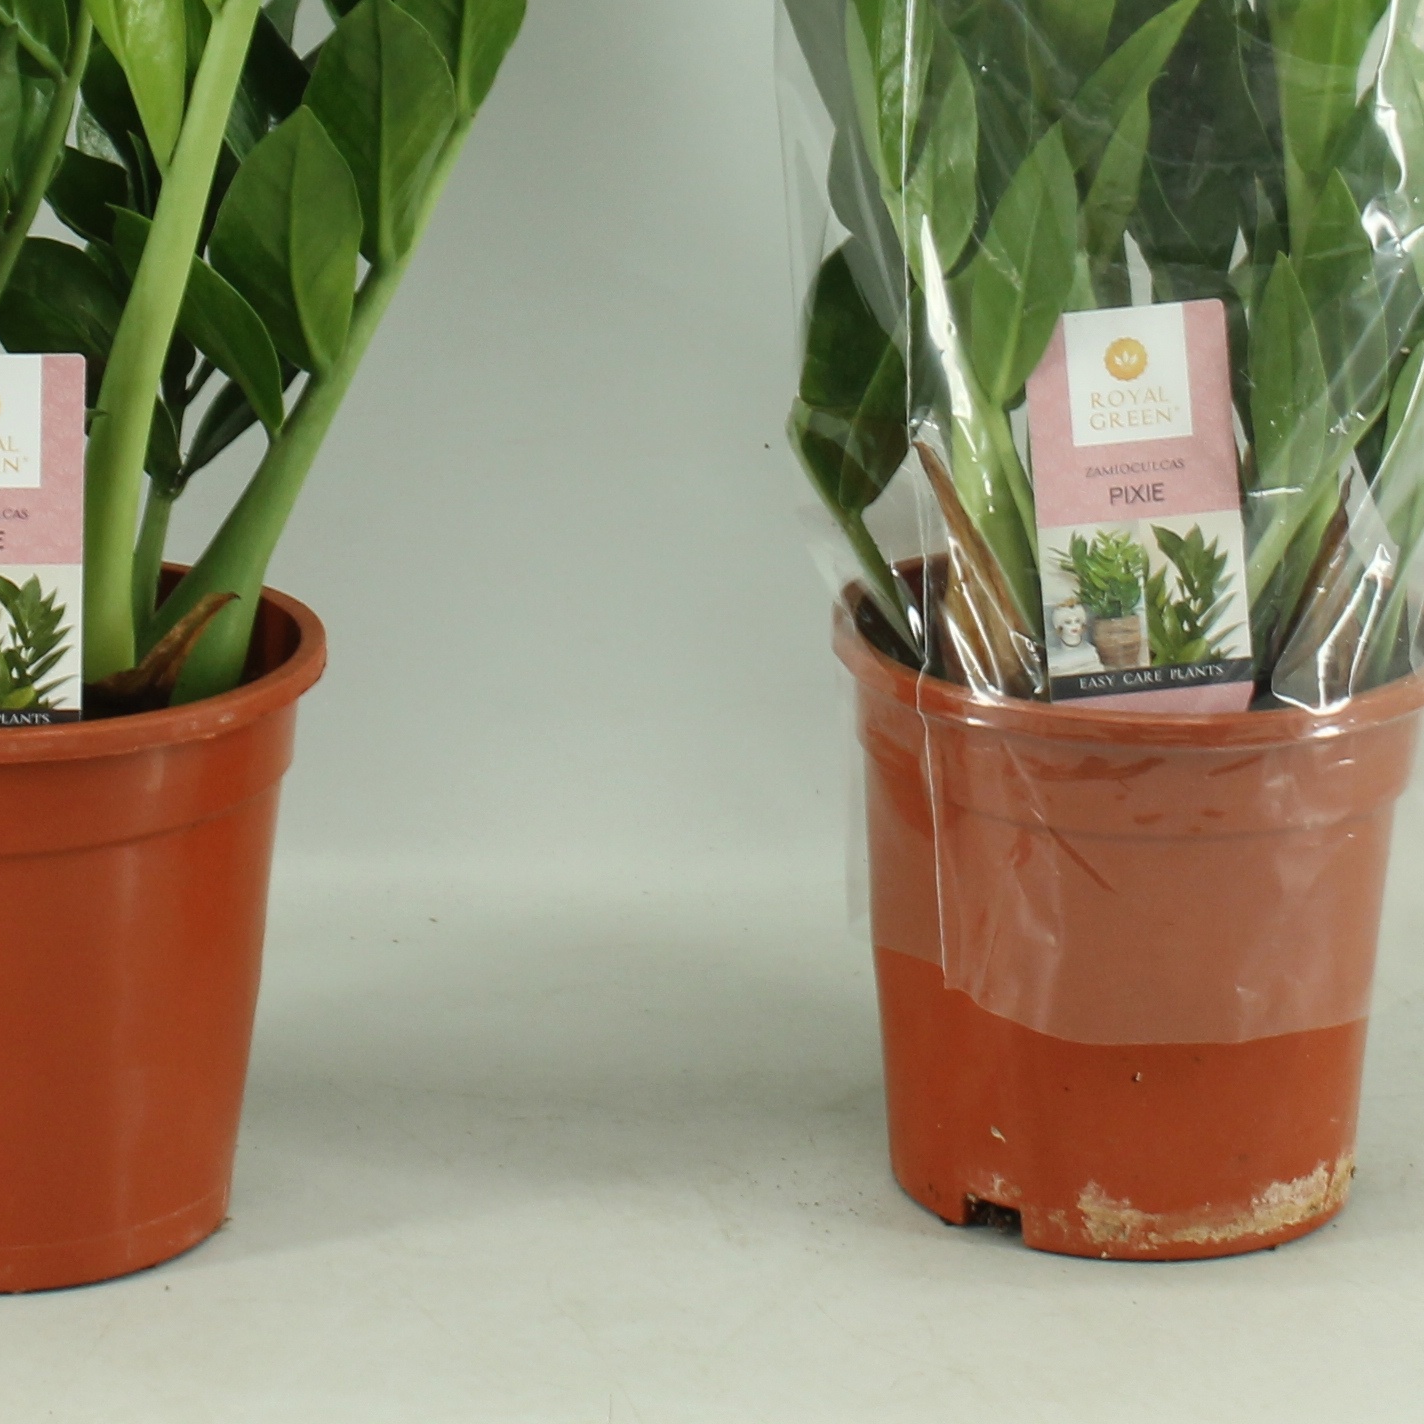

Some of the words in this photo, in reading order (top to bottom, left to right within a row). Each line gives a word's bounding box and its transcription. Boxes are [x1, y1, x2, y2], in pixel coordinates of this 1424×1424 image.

[1090, 386, 1170, 409] ROYAL
[1084, 457, 1186, 478] ZAMIOCULCAS
[1109, 482, 1165, 507] PIXIE
[1079, 673, 1115, 690] EASY
[1122, 668, 1163, 685] CARE
[1170, 663, 1224, 681] PLANTS
